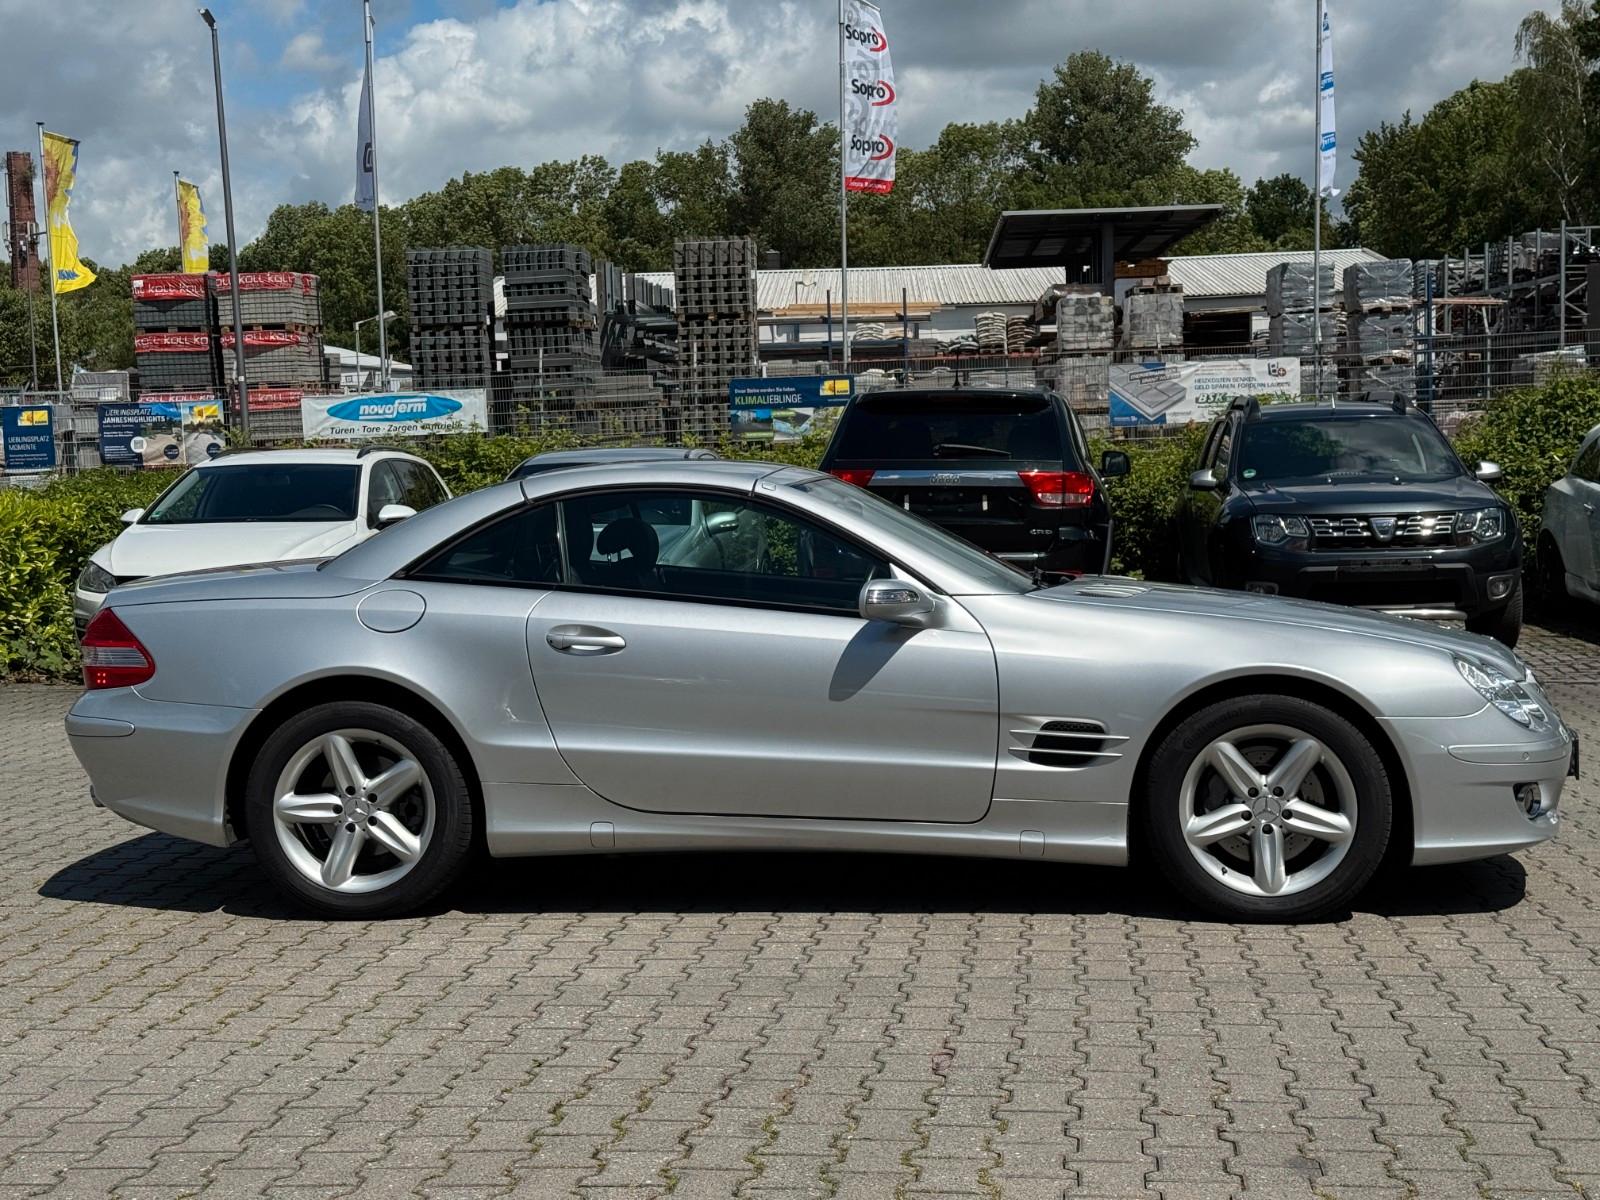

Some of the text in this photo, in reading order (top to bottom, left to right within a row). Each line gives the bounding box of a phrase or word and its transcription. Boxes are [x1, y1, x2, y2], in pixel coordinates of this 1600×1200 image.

[846, 24, 878, 45] Sopro
[852, 79, 885, 99] Sopro
[851, 135, 884, 155] Sopro
[239, 275, 264, 284] KOLL
[163, 334, 190, 345] KOLL
[735, 394, 802, 405] KLIMALIEBLINGE
[1198, 393, 1225, 402] BSK
[359, 398, 427, 419] novoferm
[102, 415, 166, 424] JAHRESHIGHLIGHTS
[330, 427, 355, 435] Türen
[387, 424, 418, 434] Zargen
[8, 435, 50, 443] LIEBLINGSPLATZ
[9, 443, 37, 451] MOMENTE
